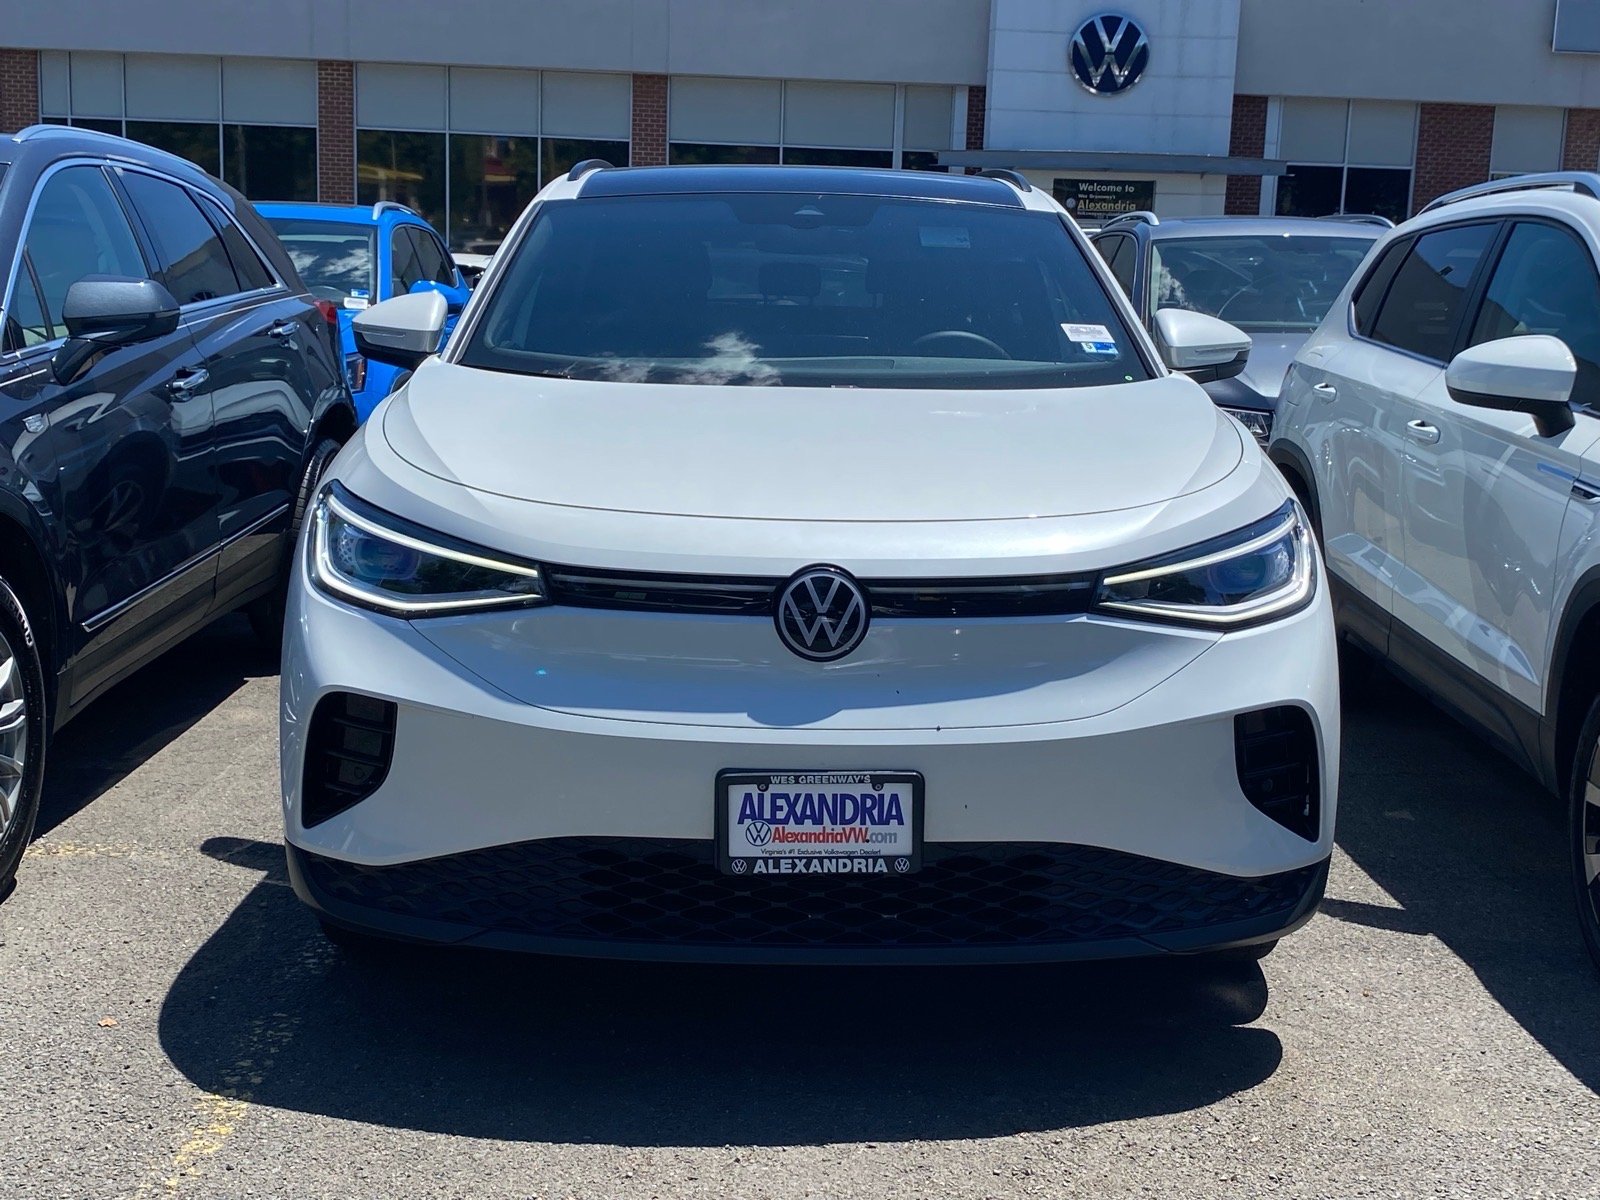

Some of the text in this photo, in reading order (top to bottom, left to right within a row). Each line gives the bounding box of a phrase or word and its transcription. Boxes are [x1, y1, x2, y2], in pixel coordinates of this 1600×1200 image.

[1079, 183, 1135, 193] Welcome to
[1077, 199, 1136, 211] Alexandria
[770, 774, 871, 785] WES GREENWAY'S
[737, 792, 905, 826] ALEXANDRIA
[772, 826, 897, 844] AlexandriaVW.com
[761, 848, 786, 856] Virginia's
[823, 848, 859, 857] Volkswagen
[753, 859, 888, 874] ALEXANDRIA
